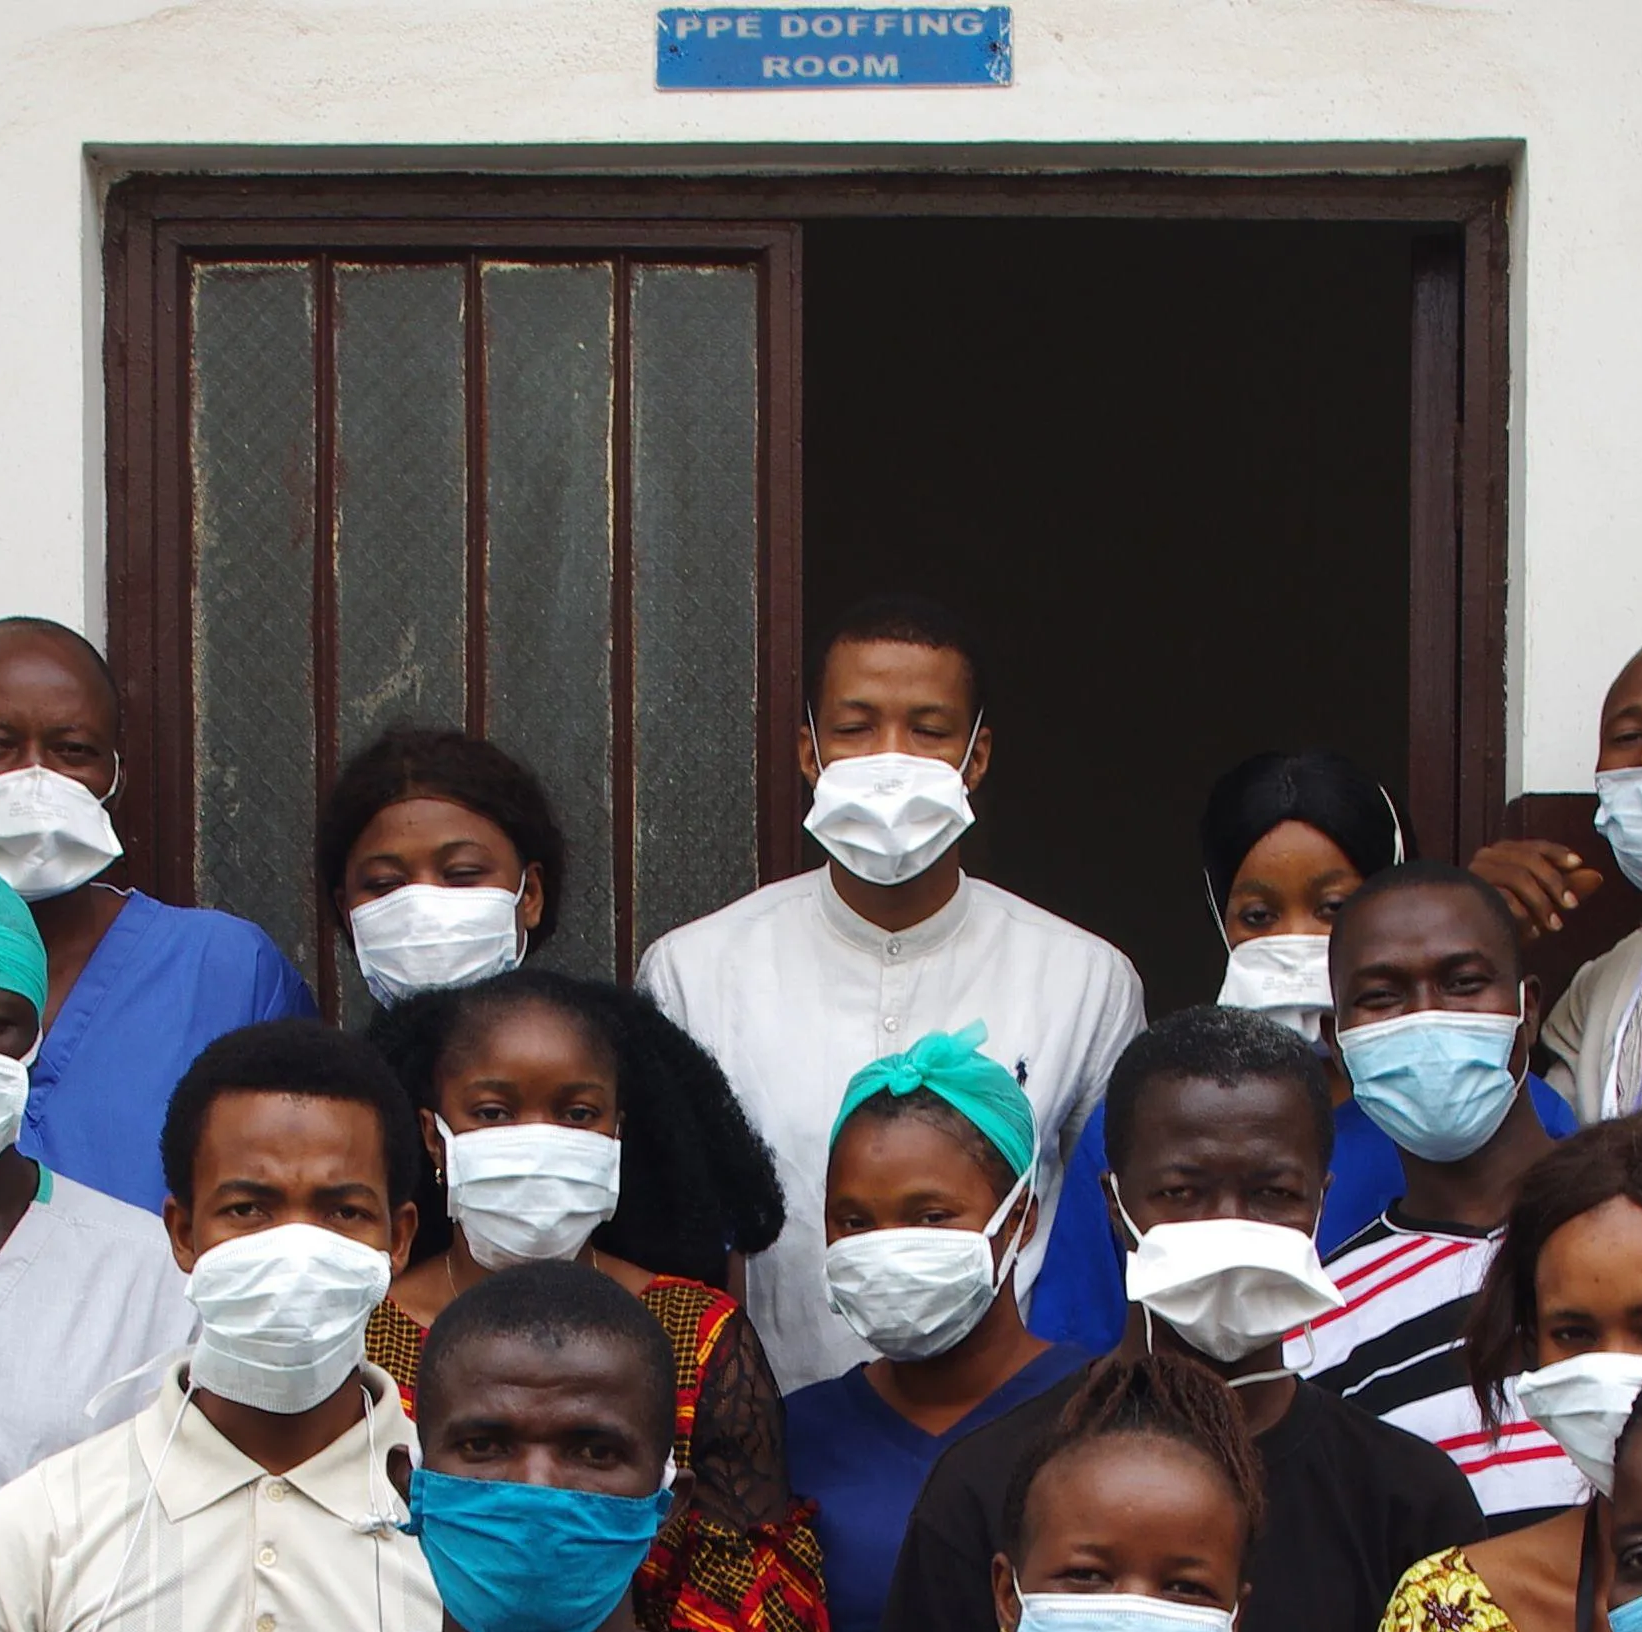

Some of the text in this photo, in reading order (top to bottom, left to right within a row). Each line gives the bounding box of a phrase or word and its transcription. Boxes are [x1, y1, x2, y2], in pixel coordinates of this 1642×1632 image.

[675, 13, 984, 39] PPE DOFFING
[761, 54, 900, 78] ROOM
